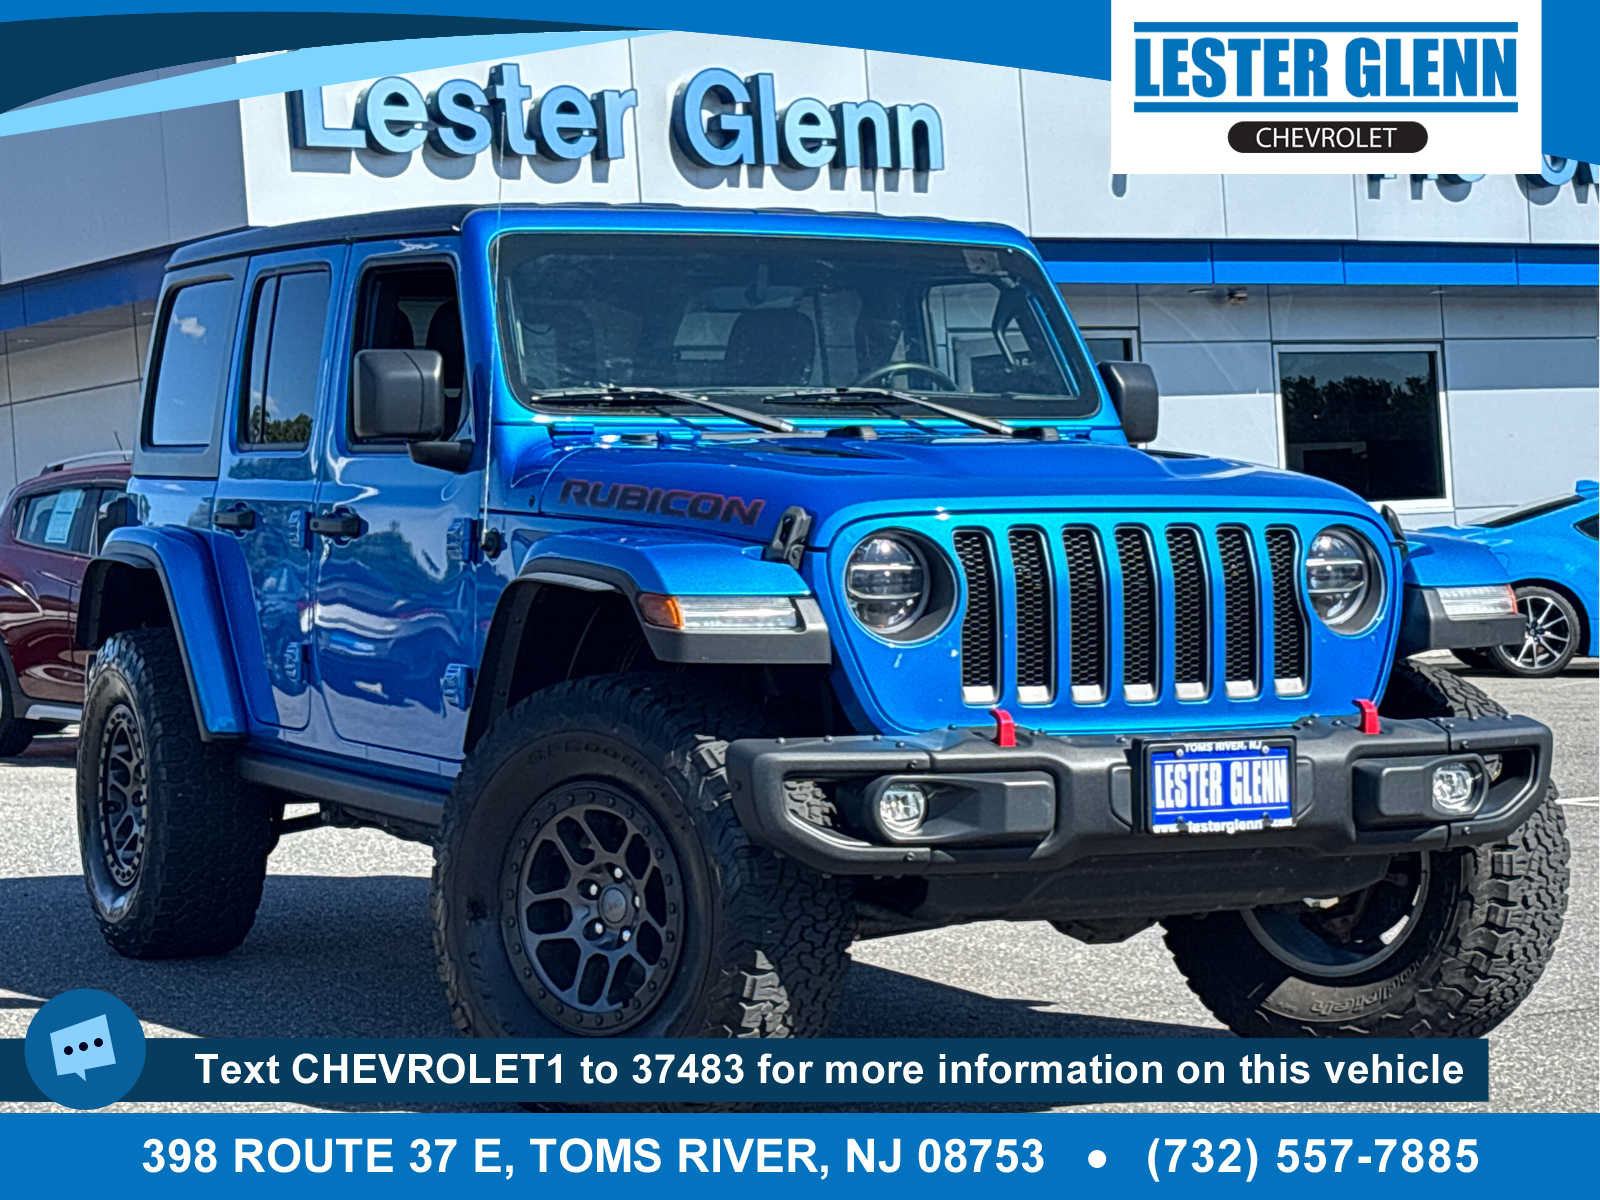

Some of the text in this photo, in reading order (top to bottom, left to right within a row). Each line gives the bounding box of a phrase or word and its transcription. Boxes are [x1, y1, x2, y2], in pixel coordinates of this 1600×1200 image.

[288, 63, 944, 170] Lester Glenn
[560, 478, 765, 526] RUBICON
[1185, 742, 1213, 752] TOMS
[1249, 740, 1262, 749] NJ
[1155, 759, 1289, 808] LESTER GLENN
[1188, 818, 1263, 835] lesterglenn
